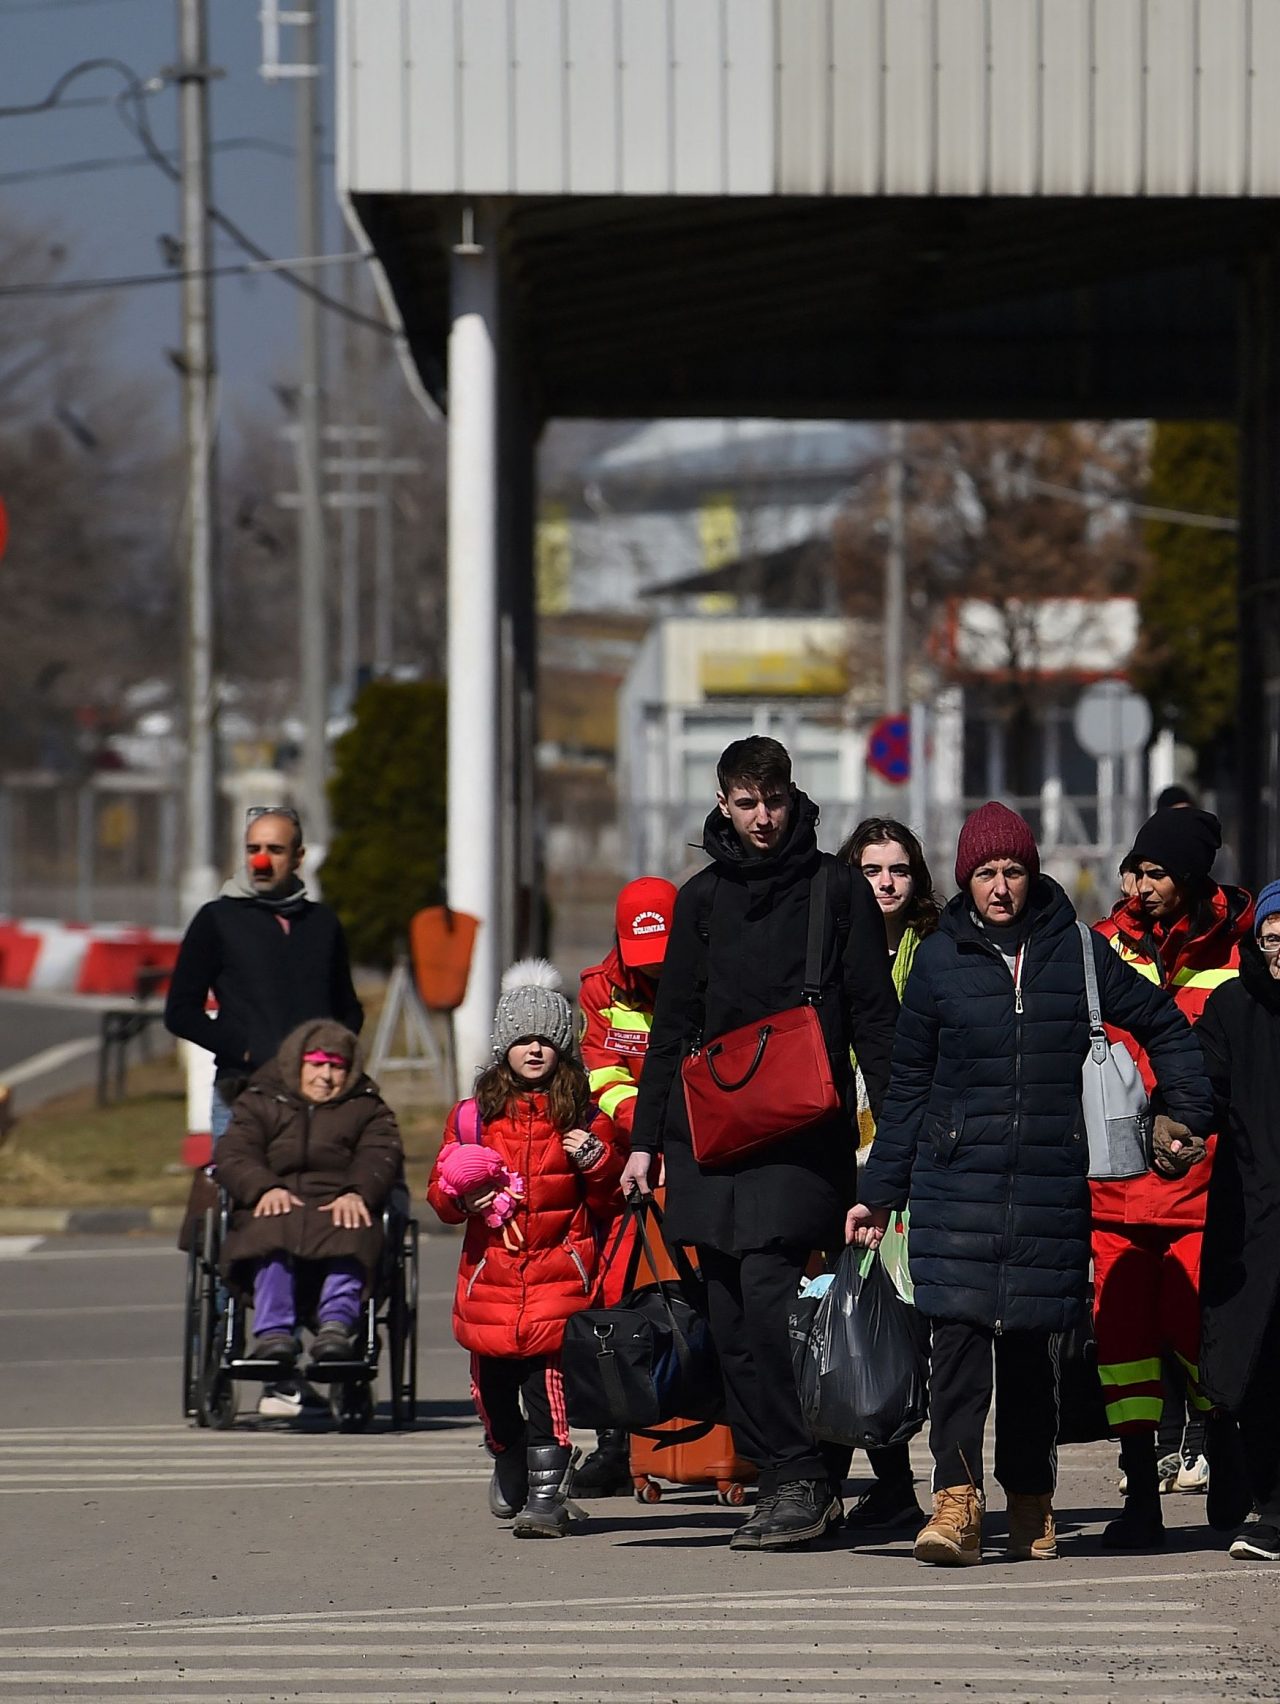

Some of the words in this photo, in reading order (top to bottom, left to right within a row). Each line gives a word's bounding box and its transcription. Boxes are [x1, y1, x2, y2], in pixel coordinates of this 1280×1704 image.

[632, 911, 664, 927] POMPIER
[632, 923, 666, 935] VOLUNTAR
[613, 1032, 641, 1041] VOLUNTAR
